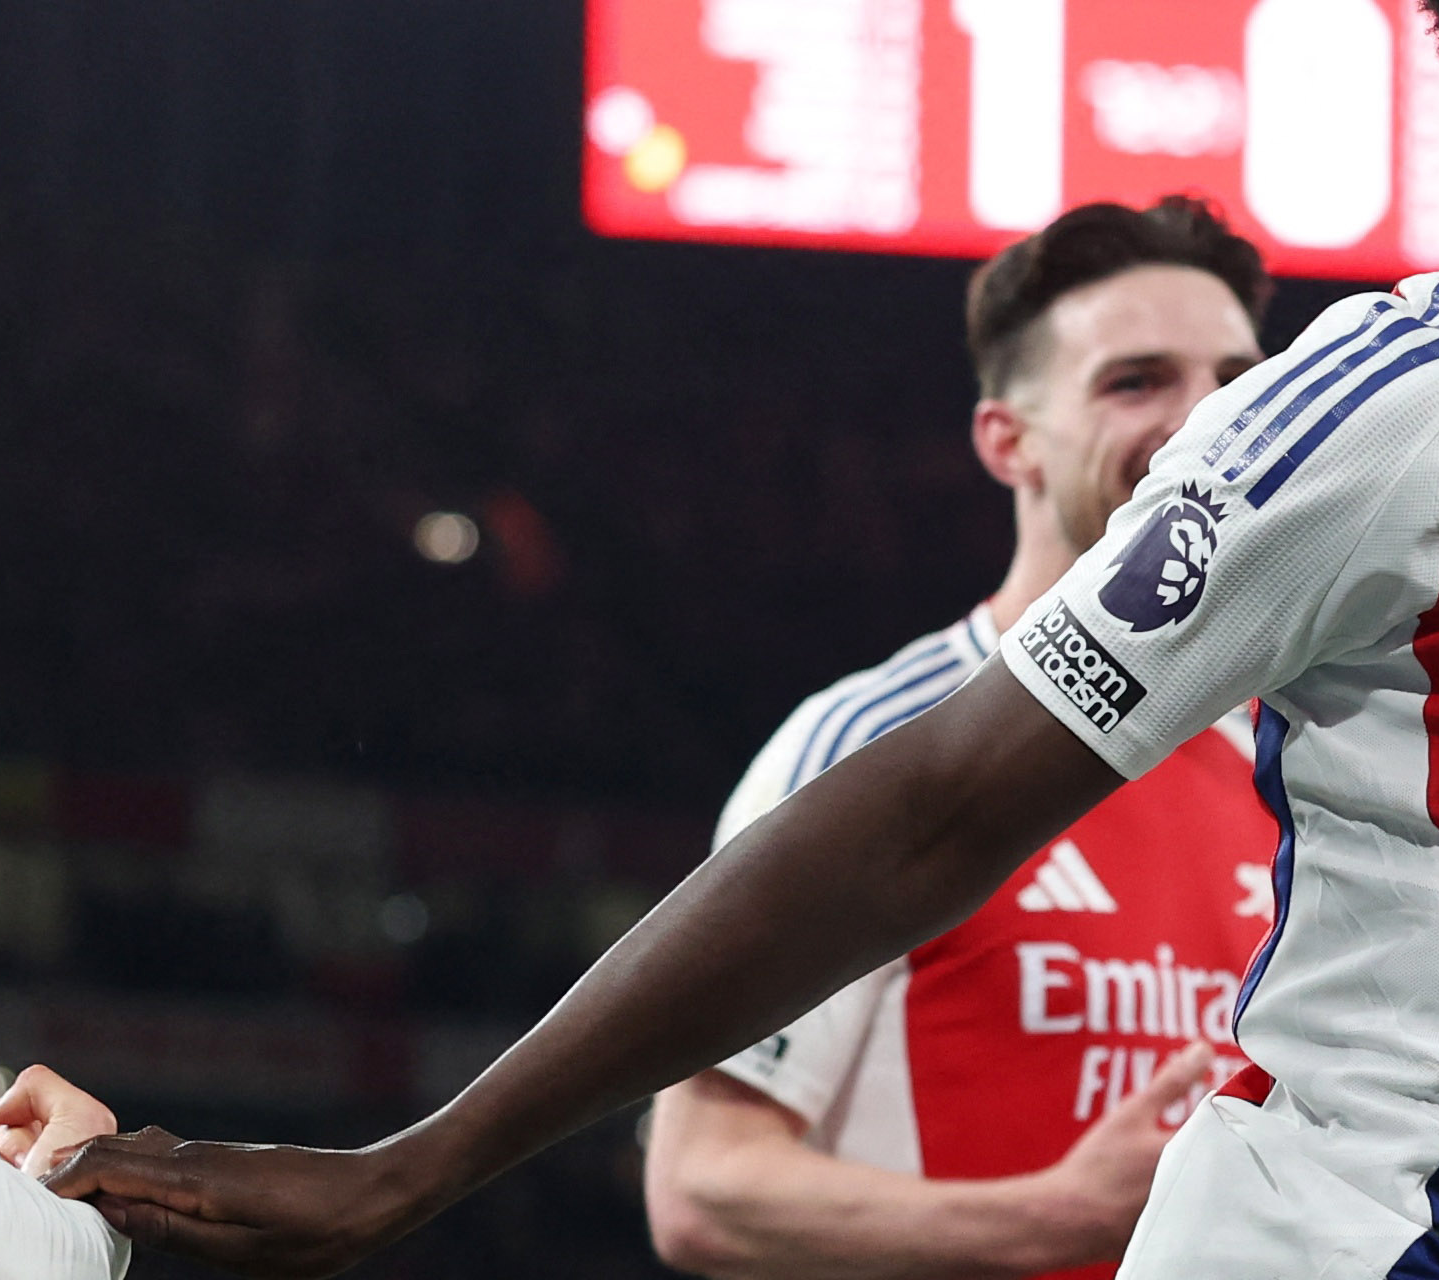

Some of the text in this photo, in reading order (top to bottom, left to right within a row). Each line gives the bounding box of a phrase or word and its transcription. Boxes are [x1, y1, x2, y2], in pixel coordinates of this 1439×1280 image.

[1034, 642, 1120, 733] racism
[1055, 623, 1128, 702] room
[1015, 941, 1241, 1044] Emira
